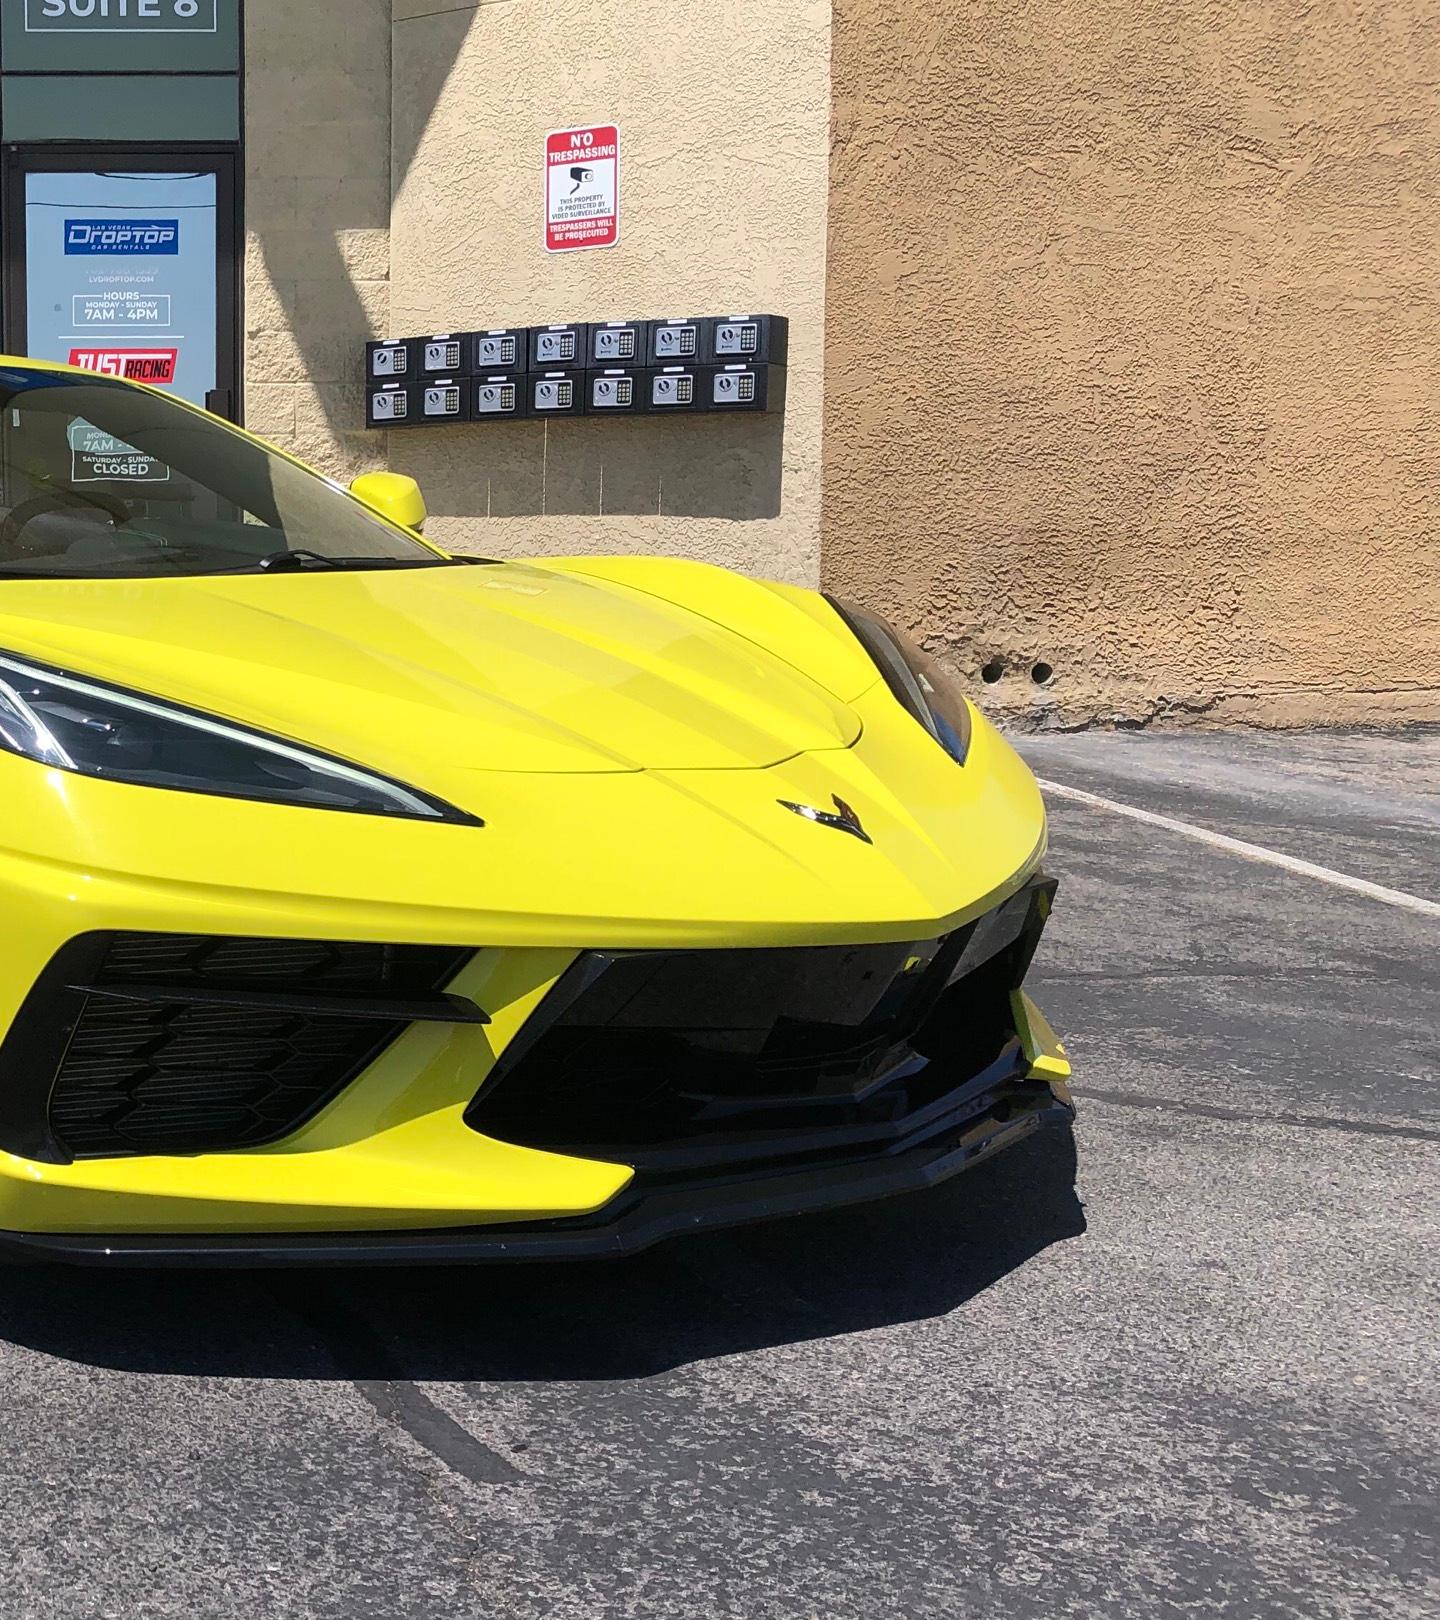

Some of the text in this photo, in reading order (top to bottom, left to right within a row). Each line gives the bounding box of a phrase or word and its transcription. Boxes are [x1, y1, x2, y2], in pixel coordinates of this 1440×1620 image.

[42, 0, 160, 17] SUITE
[571, 132, 594, 148] NO
[549, 144, 616, 163] TRESPASSING
[560, 193, 603, 205] THIS PROPERTY
[565, 202, 597, 211] PROTECTED
[570, 207, 611, 218] SURVEILLANCE
[550, 218, 613, 233] TRESPASSERS WILL
[554, 228, 609, 241] BE PROSECUTED
[103, 291, 140, 301] HOURS
[86, 301, 120, 309] MONDAY
[125, 301, 158, 309] SUNDAY
[84, 309, 115, 320] 7AM
[127, 309, 158, 320] 4PM
[124, 359, 171, 379] RACING
[83, 439, 114, 451] 7AM
[82, 456, 122, 464] SATURDAY
[127, 455, 159, 464] SUNDA
[93, 463, 149, 475] CLOSED
